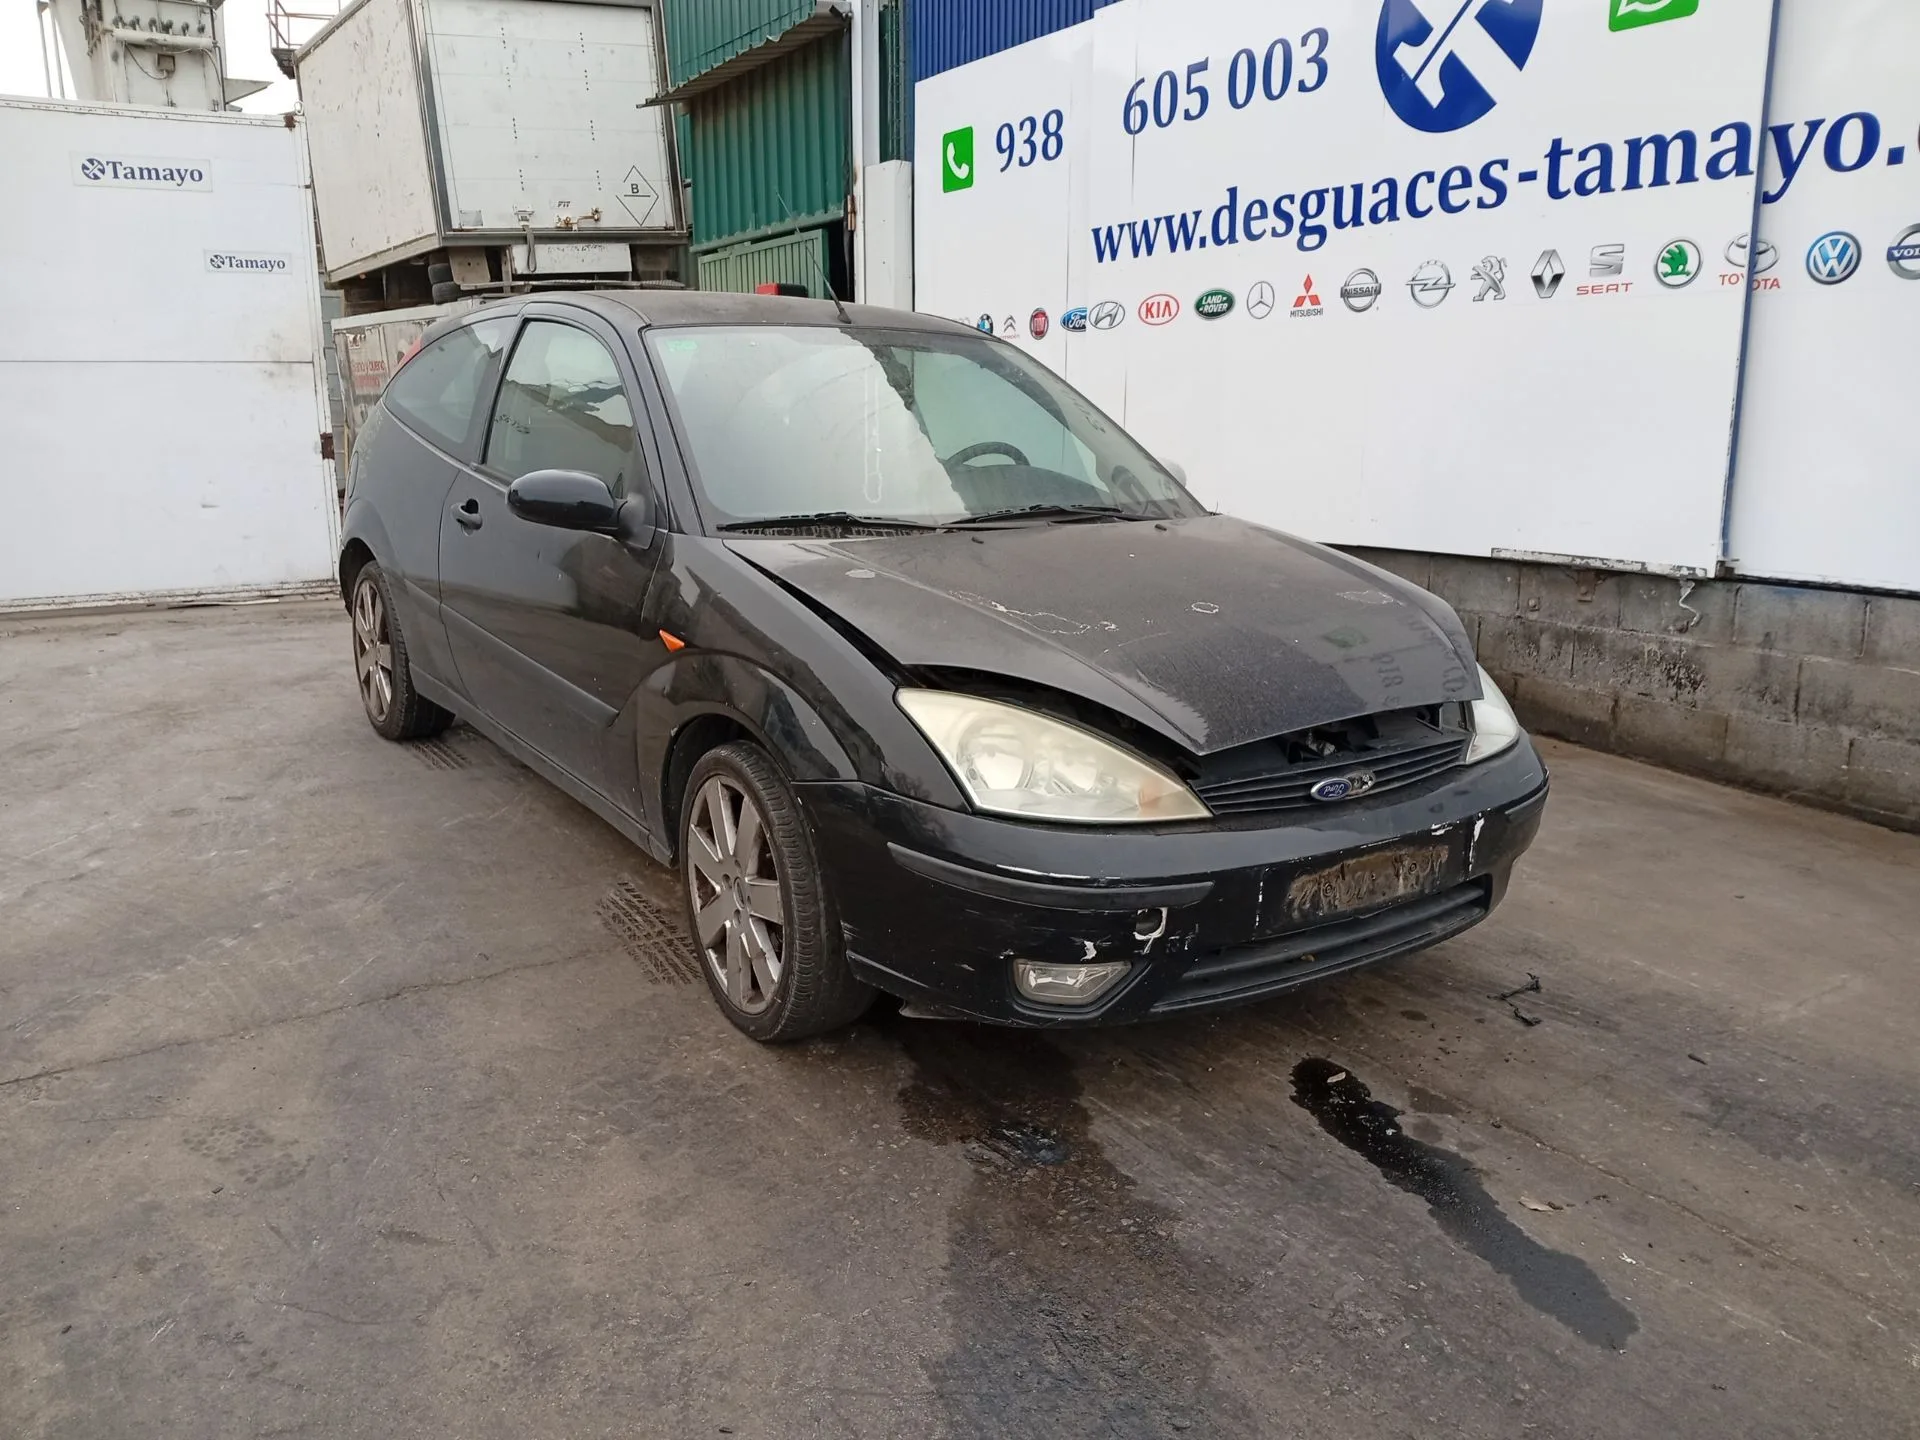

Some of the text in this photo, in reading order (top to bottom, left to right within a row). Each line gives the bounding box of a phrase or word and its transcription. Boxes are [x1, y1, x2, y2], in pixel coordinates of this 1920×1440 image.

[995, 26, 1330, 173] 938 605 003
[106, 160, 203, 187] Tamayo
[630, 183, 640, 194] B
[1091, 111, 1920, 264] www.desguaces-tamayo.
[225, 255, 286, 272] Tamayo
[1576, 282, 1634, 296] SEAT
[1719, 273, 1781, 291] TOOTA
[1343, 285, 1379, 297] NISSAN
[1145, 301, 1172, 319] KIA
[1289, 308, 1324, 319] MITSUBISHI
[1323, 784, 1345, 798] Ford
